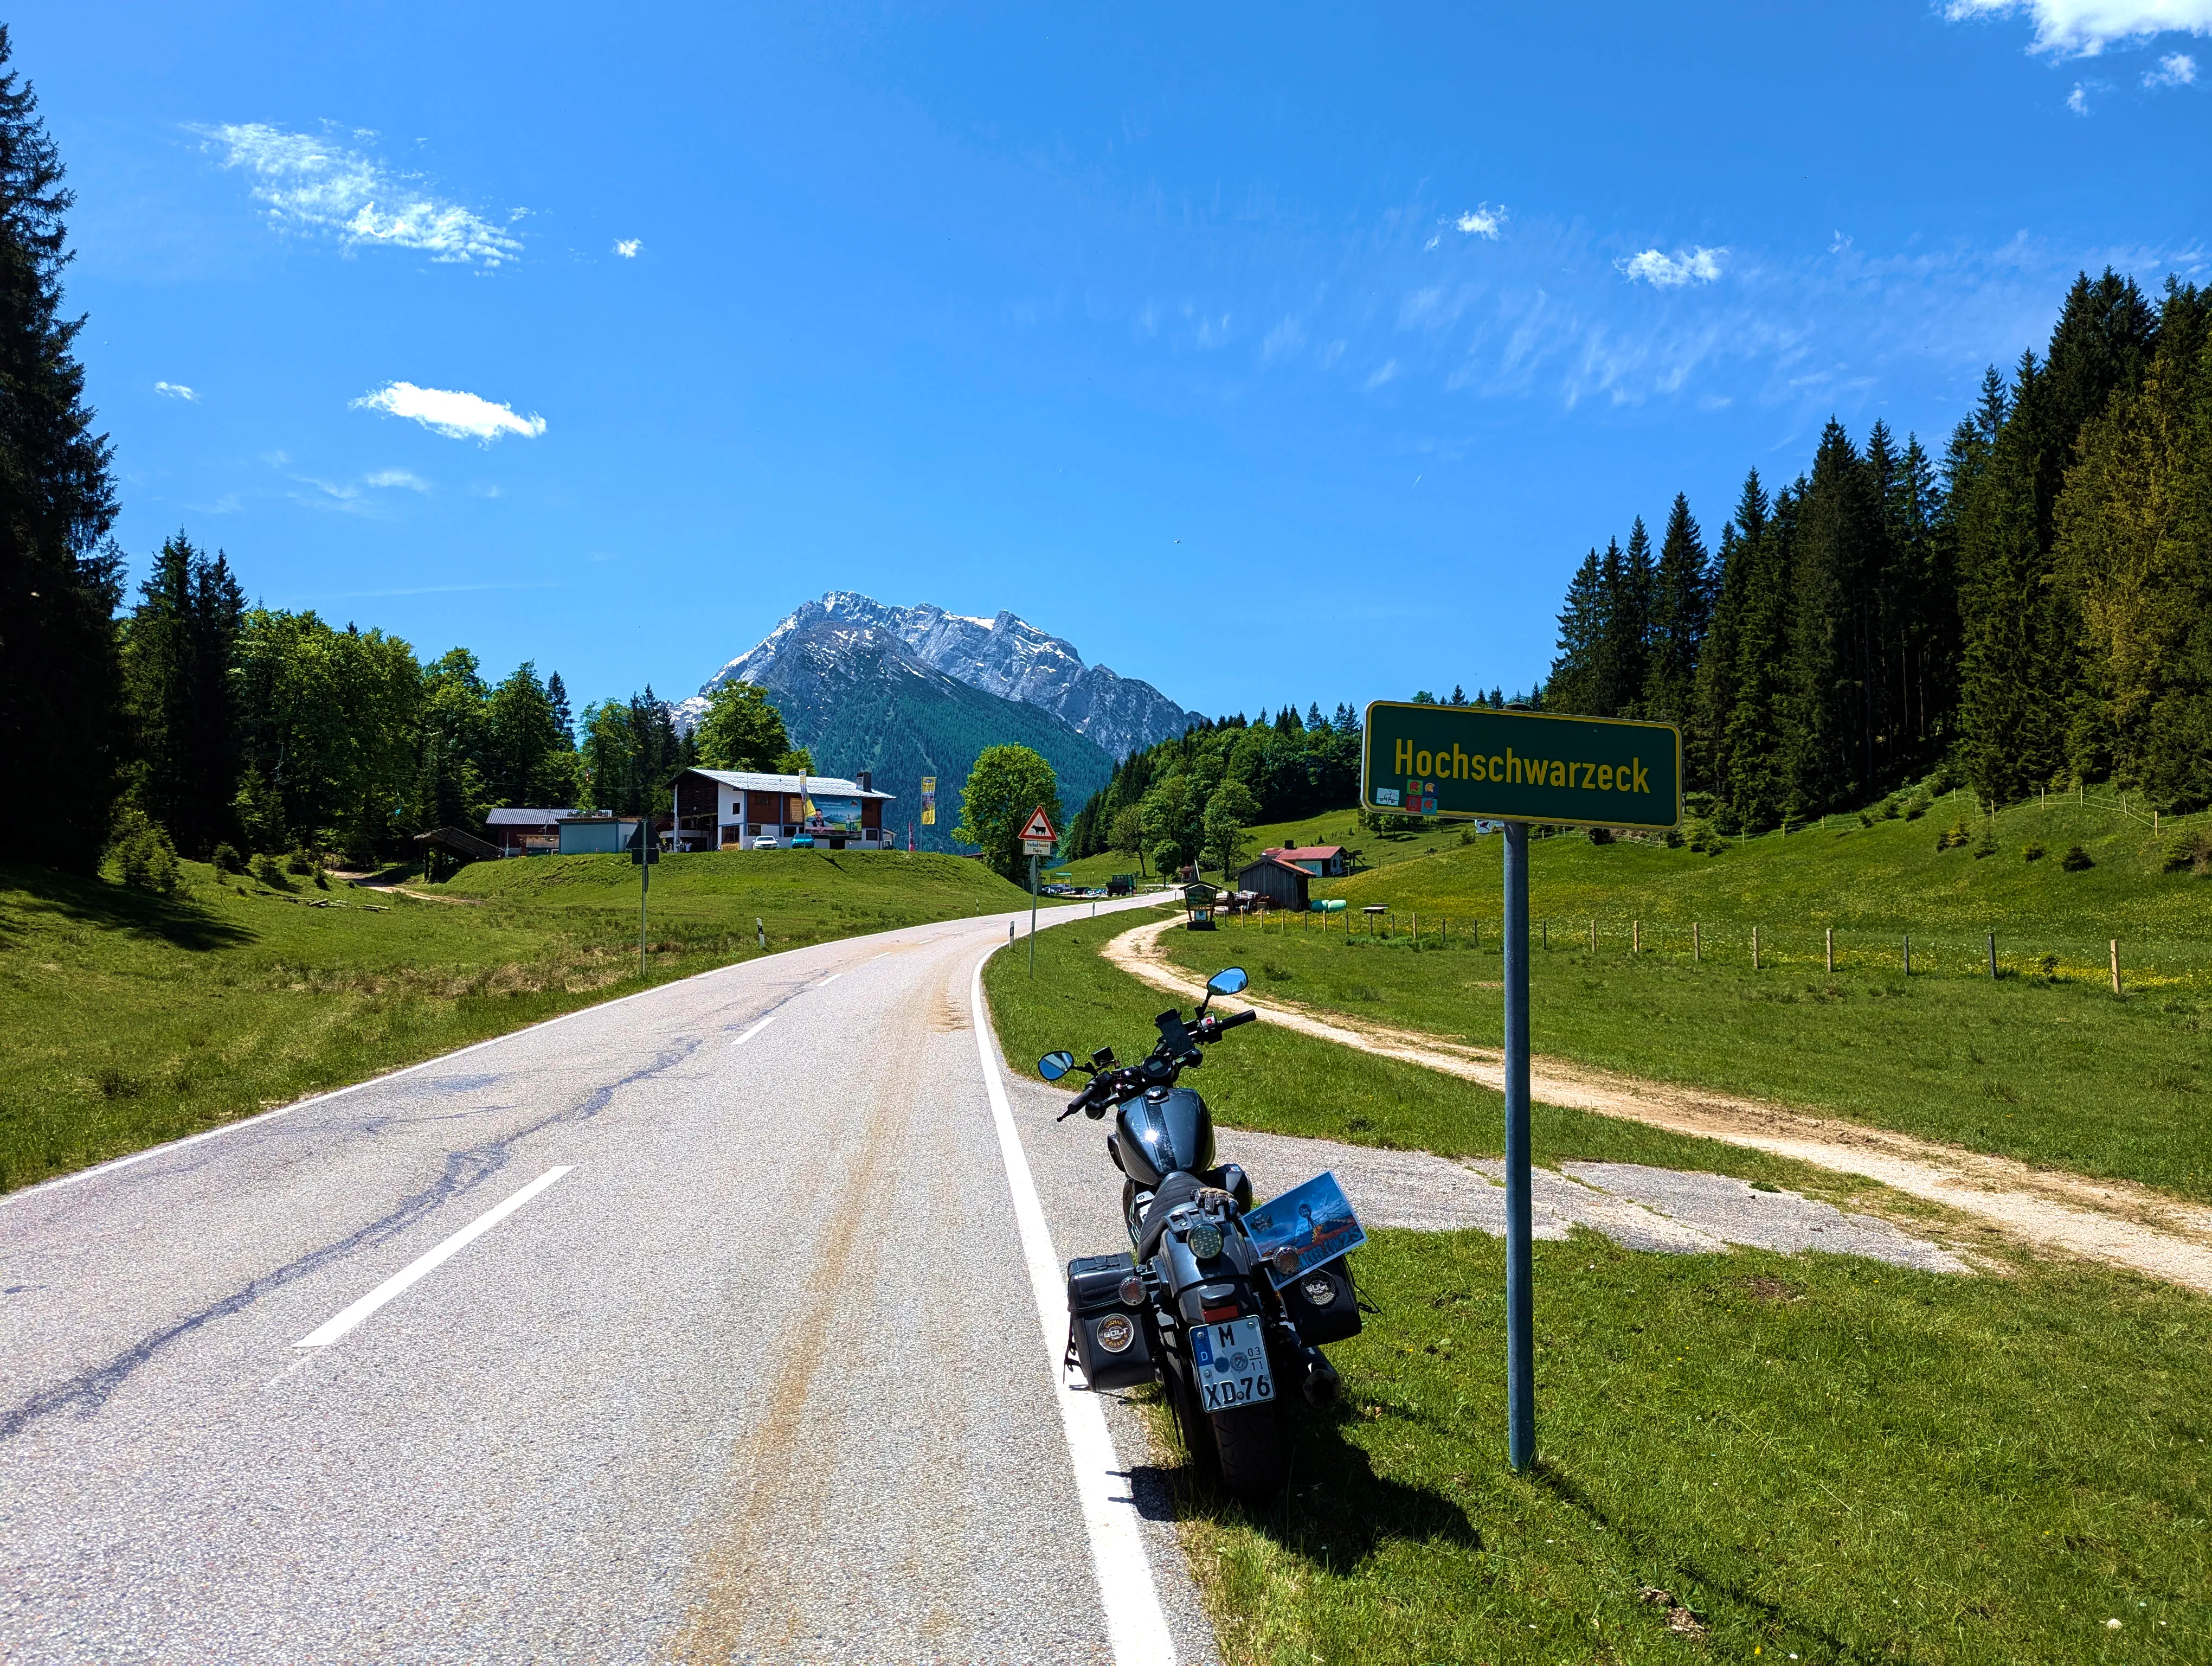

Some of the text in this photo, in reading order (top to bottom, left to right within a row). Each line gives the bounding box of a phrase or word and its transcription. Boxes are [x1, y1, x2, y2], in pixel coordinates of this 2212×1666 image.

[1396, 738, 1650, 793] Hochschwarzeck
[1339, 1226, 1362, 1247] 25
[1105, 1319, 1123, 1328] GERMAN
[1104, 1328, 1128, 1338] BOLT
[1218, 1324, 1235, 1348] M
[1200, 1351, 1208, 1361] D
[1248, 1346, 1261, 1357] 03
[1251, 1361, 1263, 1371] 11
[1204, 1374, 1270, 1408] XD 76
